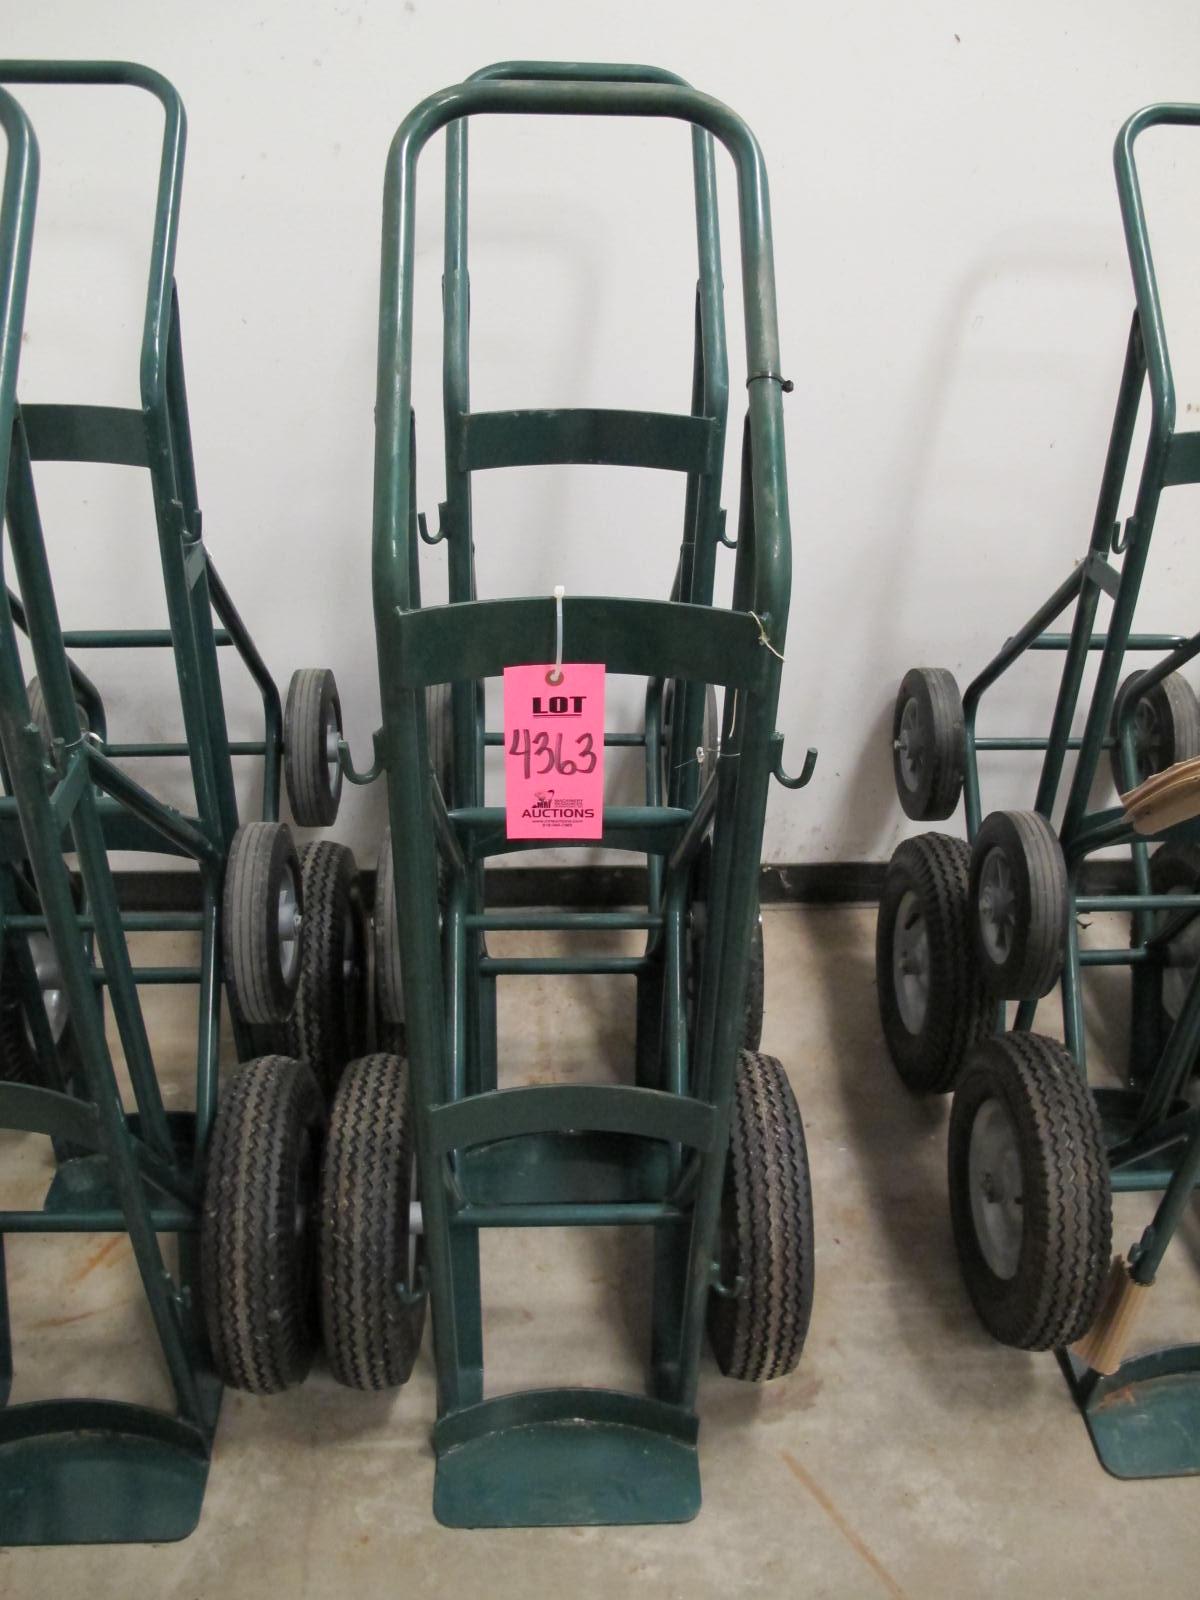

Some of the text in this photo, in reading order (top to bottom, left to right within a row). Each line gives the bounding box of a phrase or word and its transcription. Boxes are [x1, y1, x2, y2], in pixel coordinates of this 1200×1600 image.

[532, 696, 586, 714] LOT
[509, 729, 597, 779] 4363
[521, 808, 595, 818] AUCTIONS
